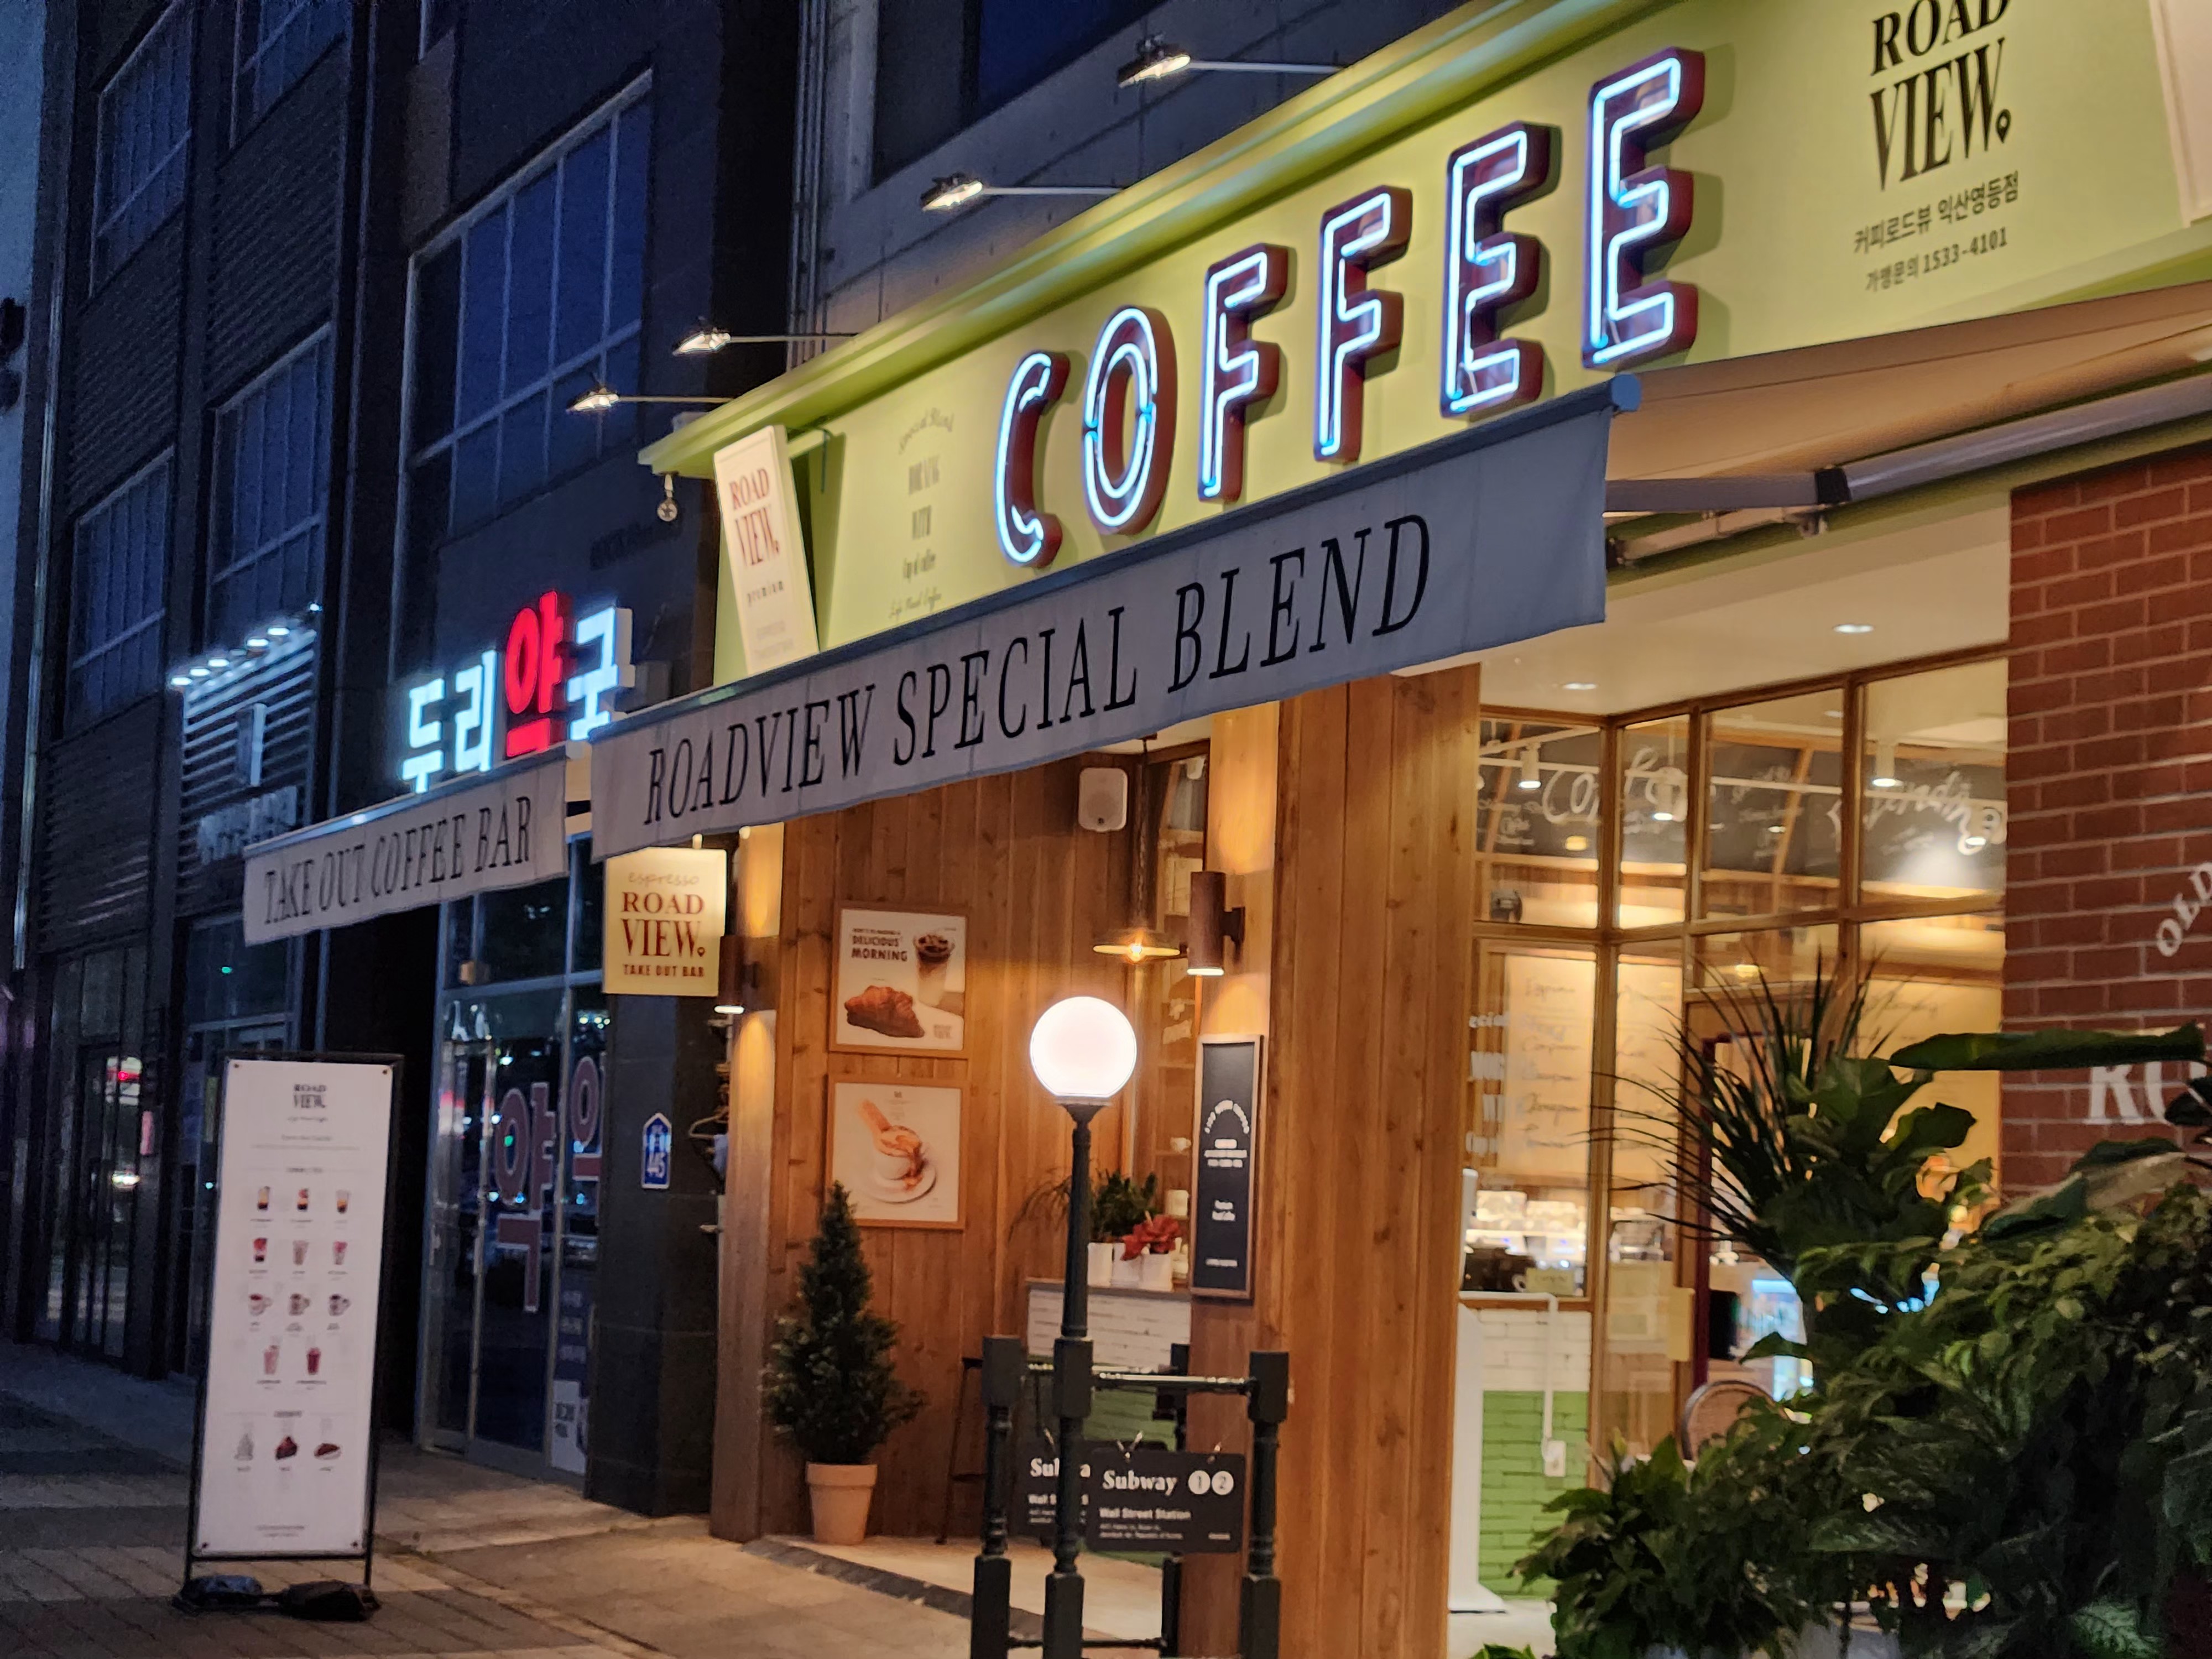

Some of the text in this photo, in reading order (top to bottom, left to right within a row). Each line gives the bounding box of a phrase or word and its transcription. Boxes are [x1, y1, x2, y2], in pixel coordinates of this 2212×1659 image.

[1854, 170, 2018, 254] 커피로드뷰 익산영등점
[1923, 226, 2008, 274] 1533-4101
[997, 46, 1705, 568] COFFEE
[728, 468, 770, 510] ROAD
[644, 514, 1430, 826] ROADVIEW SPECIAL BLEND
[264, 859, 315, 924] TAKE
[319, 843, 365, 911] OUT
[371, 813, 466, 898] COFFEE
[474, 796, 531, 873] BAR
[628, 872, 701, 888] espresso
[621, 891, 705, 914] ROAD
[620, 917, 702, 958] VIEW
[851, 947, 908, 962] MORNING
[623, 964, 705, 978] TAKE OUT BAR
[1102, 1469, 1179, 1496] Subway
